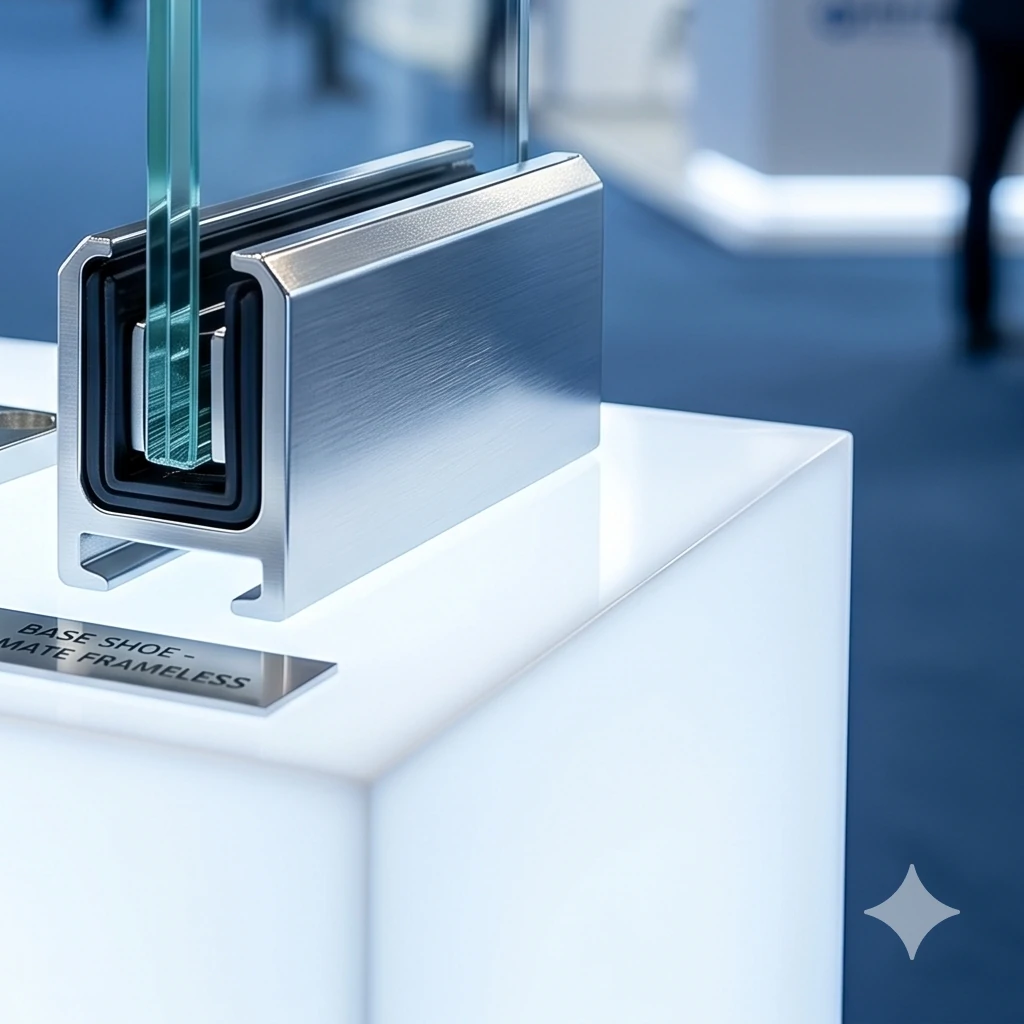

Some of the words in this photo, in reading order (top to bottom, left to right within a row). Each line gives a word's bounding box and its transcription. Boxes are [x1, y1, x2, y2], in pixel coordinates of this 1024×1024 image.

[17, 623, 97, 645] BASE
[98, 637, 181, 659] SHOE
[76, 651, 251, 690] FRAMELESS
